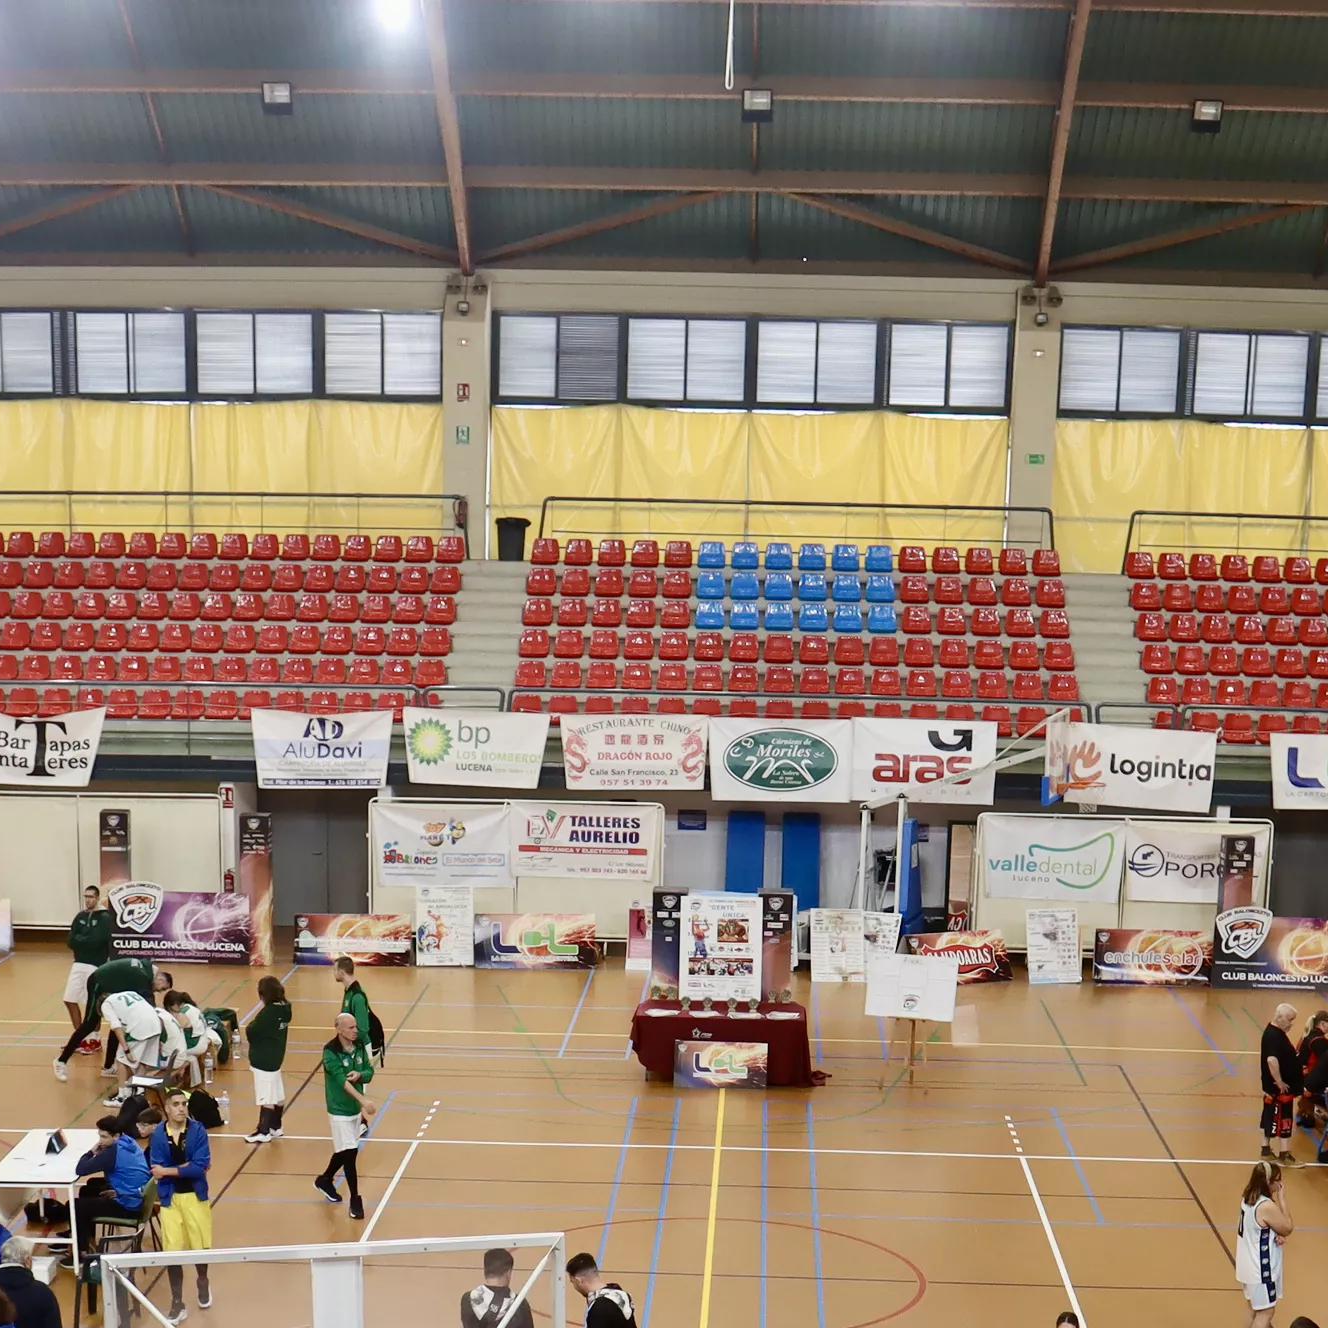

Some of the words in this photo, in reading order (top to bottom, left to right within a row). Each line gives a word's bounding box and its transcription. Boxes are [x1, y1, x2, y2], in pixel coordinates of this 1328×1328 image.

[457, 719, 491, 749] bp
[578, 718, 655, 736] RESTAURANTE
[660, 720, 691, 734] CHINO
[803, 737, 812, 745] de
[282, 741, 362, 758] AluDavi
[456, 749, 477, 760] LOS
[597, 750, 643, 761] DRAGÓN
[645, 752, 673, 761] ROJO
[756, 744, 812, 758] Moriles
[455, 763, 493, 773] LUCENA
[589, 768, 609, 776] Calle
[611, 768, 626, 776] San
[627, 768, 667, 777] Francisco,
[669, 768, 679, 776] 23
[872, 753, 973, 785] aras
[1109, 752, 1212, 787] logintia
[569, 815, 641, 829] TALLERES
[568, 830, 640, 844] AURELIO
[989, 854, 1097, 876] valledental
[1012, 874, 1050, 883] lucena
[121, 902, 158, 924] CBL
[1227, 927, 1264, 948] CBL
[113, 940, 140, 949] CLUB
[141, 940, 205, 951] BALONCESTO
[207, 941, 246, 952] LUCENA
[1104, 950, 1201, 966] enchufesolar
[1221, 971, 1246, 982] CLUB
[1247, 972, 1310, 983] BALONCESTO
